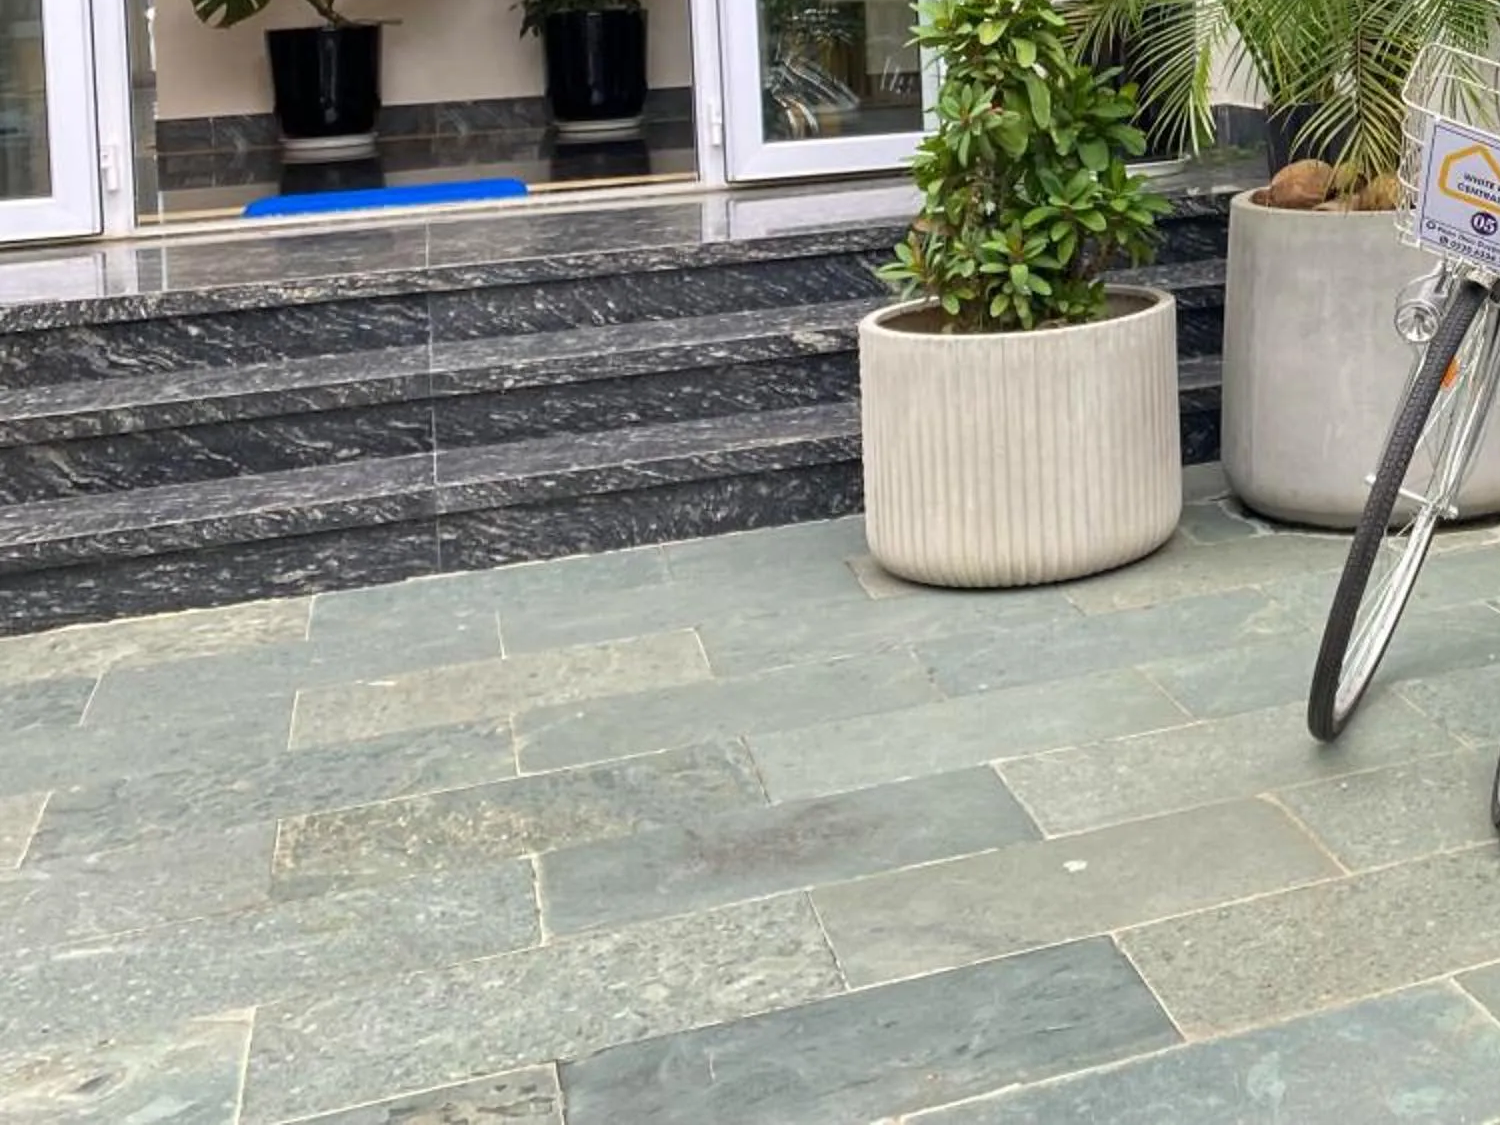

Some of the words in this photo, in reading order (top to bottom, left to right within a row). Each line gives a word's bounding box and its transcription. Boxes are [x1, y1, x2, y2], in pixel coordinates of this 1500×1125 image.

[1464, 173, 1495, 190] WHITE
[1458, 183, 1500, 203] CENTRAL
[1473, 214, 1498, 234] 05
